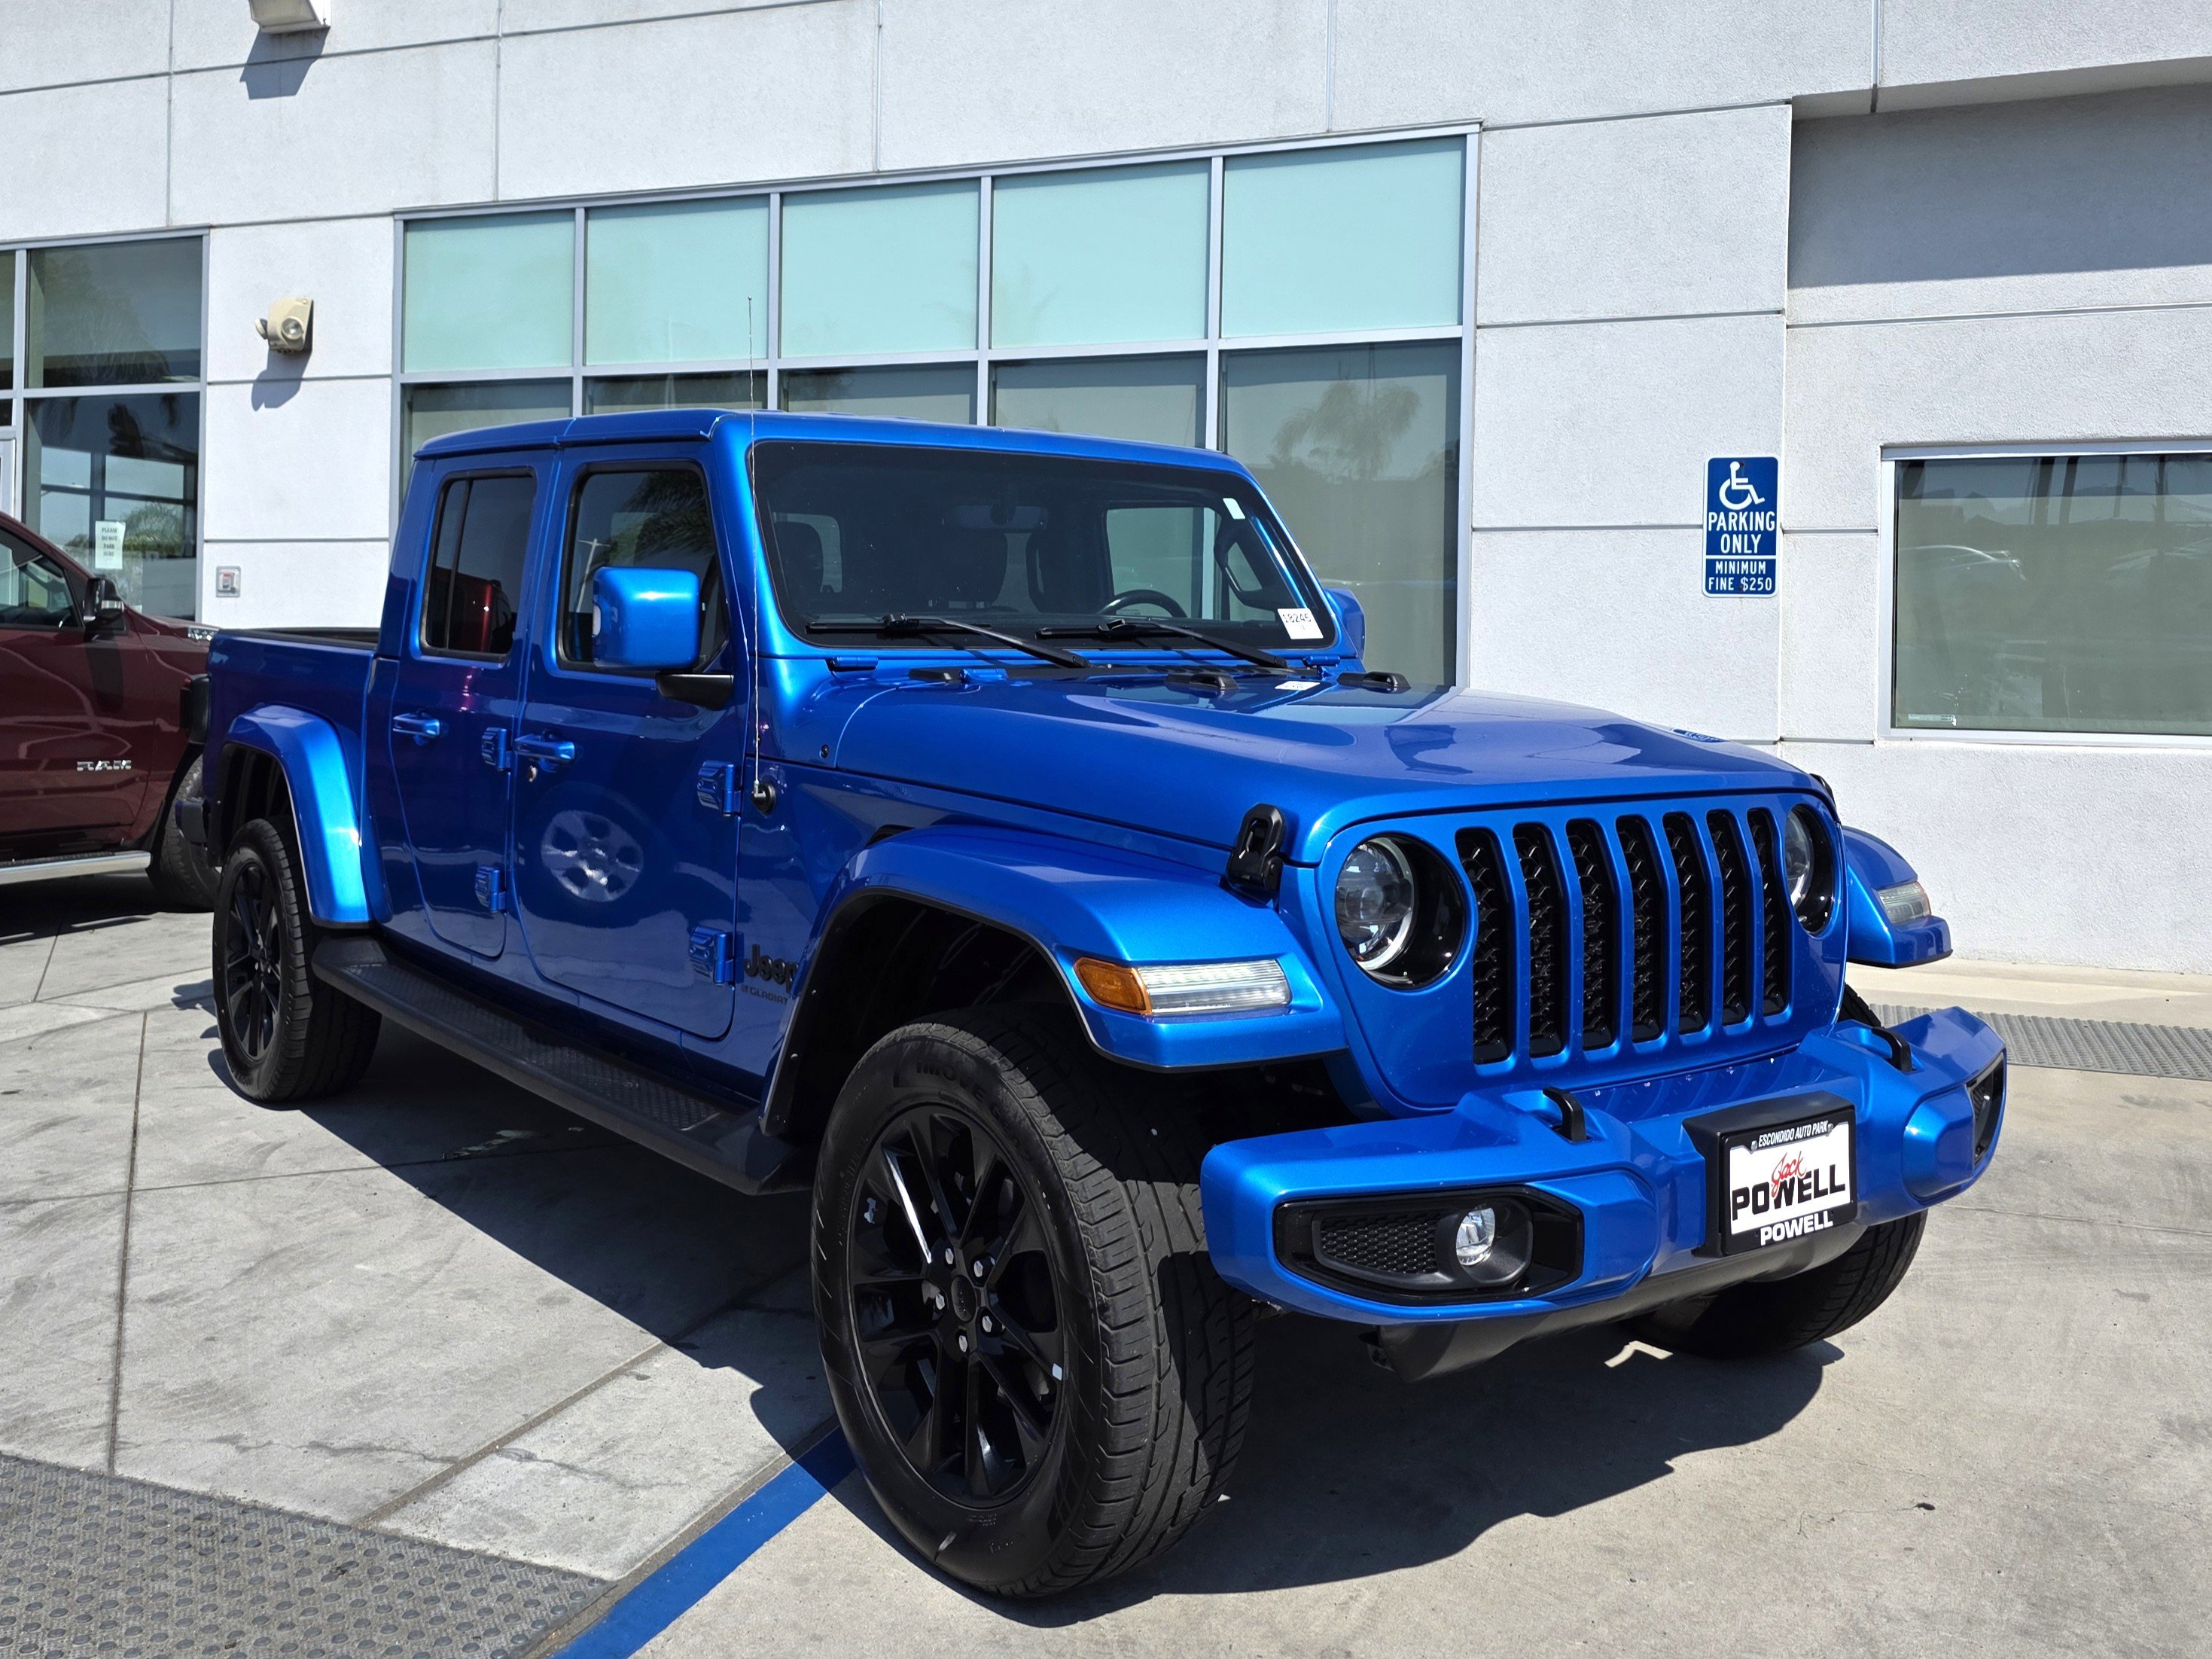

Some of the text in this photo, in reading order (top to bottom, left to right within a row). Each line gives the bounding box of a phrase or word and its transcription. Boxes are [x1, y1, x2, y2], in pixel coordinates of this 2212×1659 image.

[1708, 511, 1775, 532] PARKING
[1720, 533, 1762, 554] ONLY
[1715, 560, 1766, 575] MINIMUM
[1708, 576, 1772, 592] FINE $250
[77, 760, 132, 771] RAM
[743, 944, 799, 993] Jeep
[1758, 1120, 1829, 1148] ESCONDIDO AUTO PARK
[1771, 1151, 1807, 1198] Jack
[1732, 1163, 1846, 1221] POWELL
[1760, 1210, 1834, 1246] POWELL
